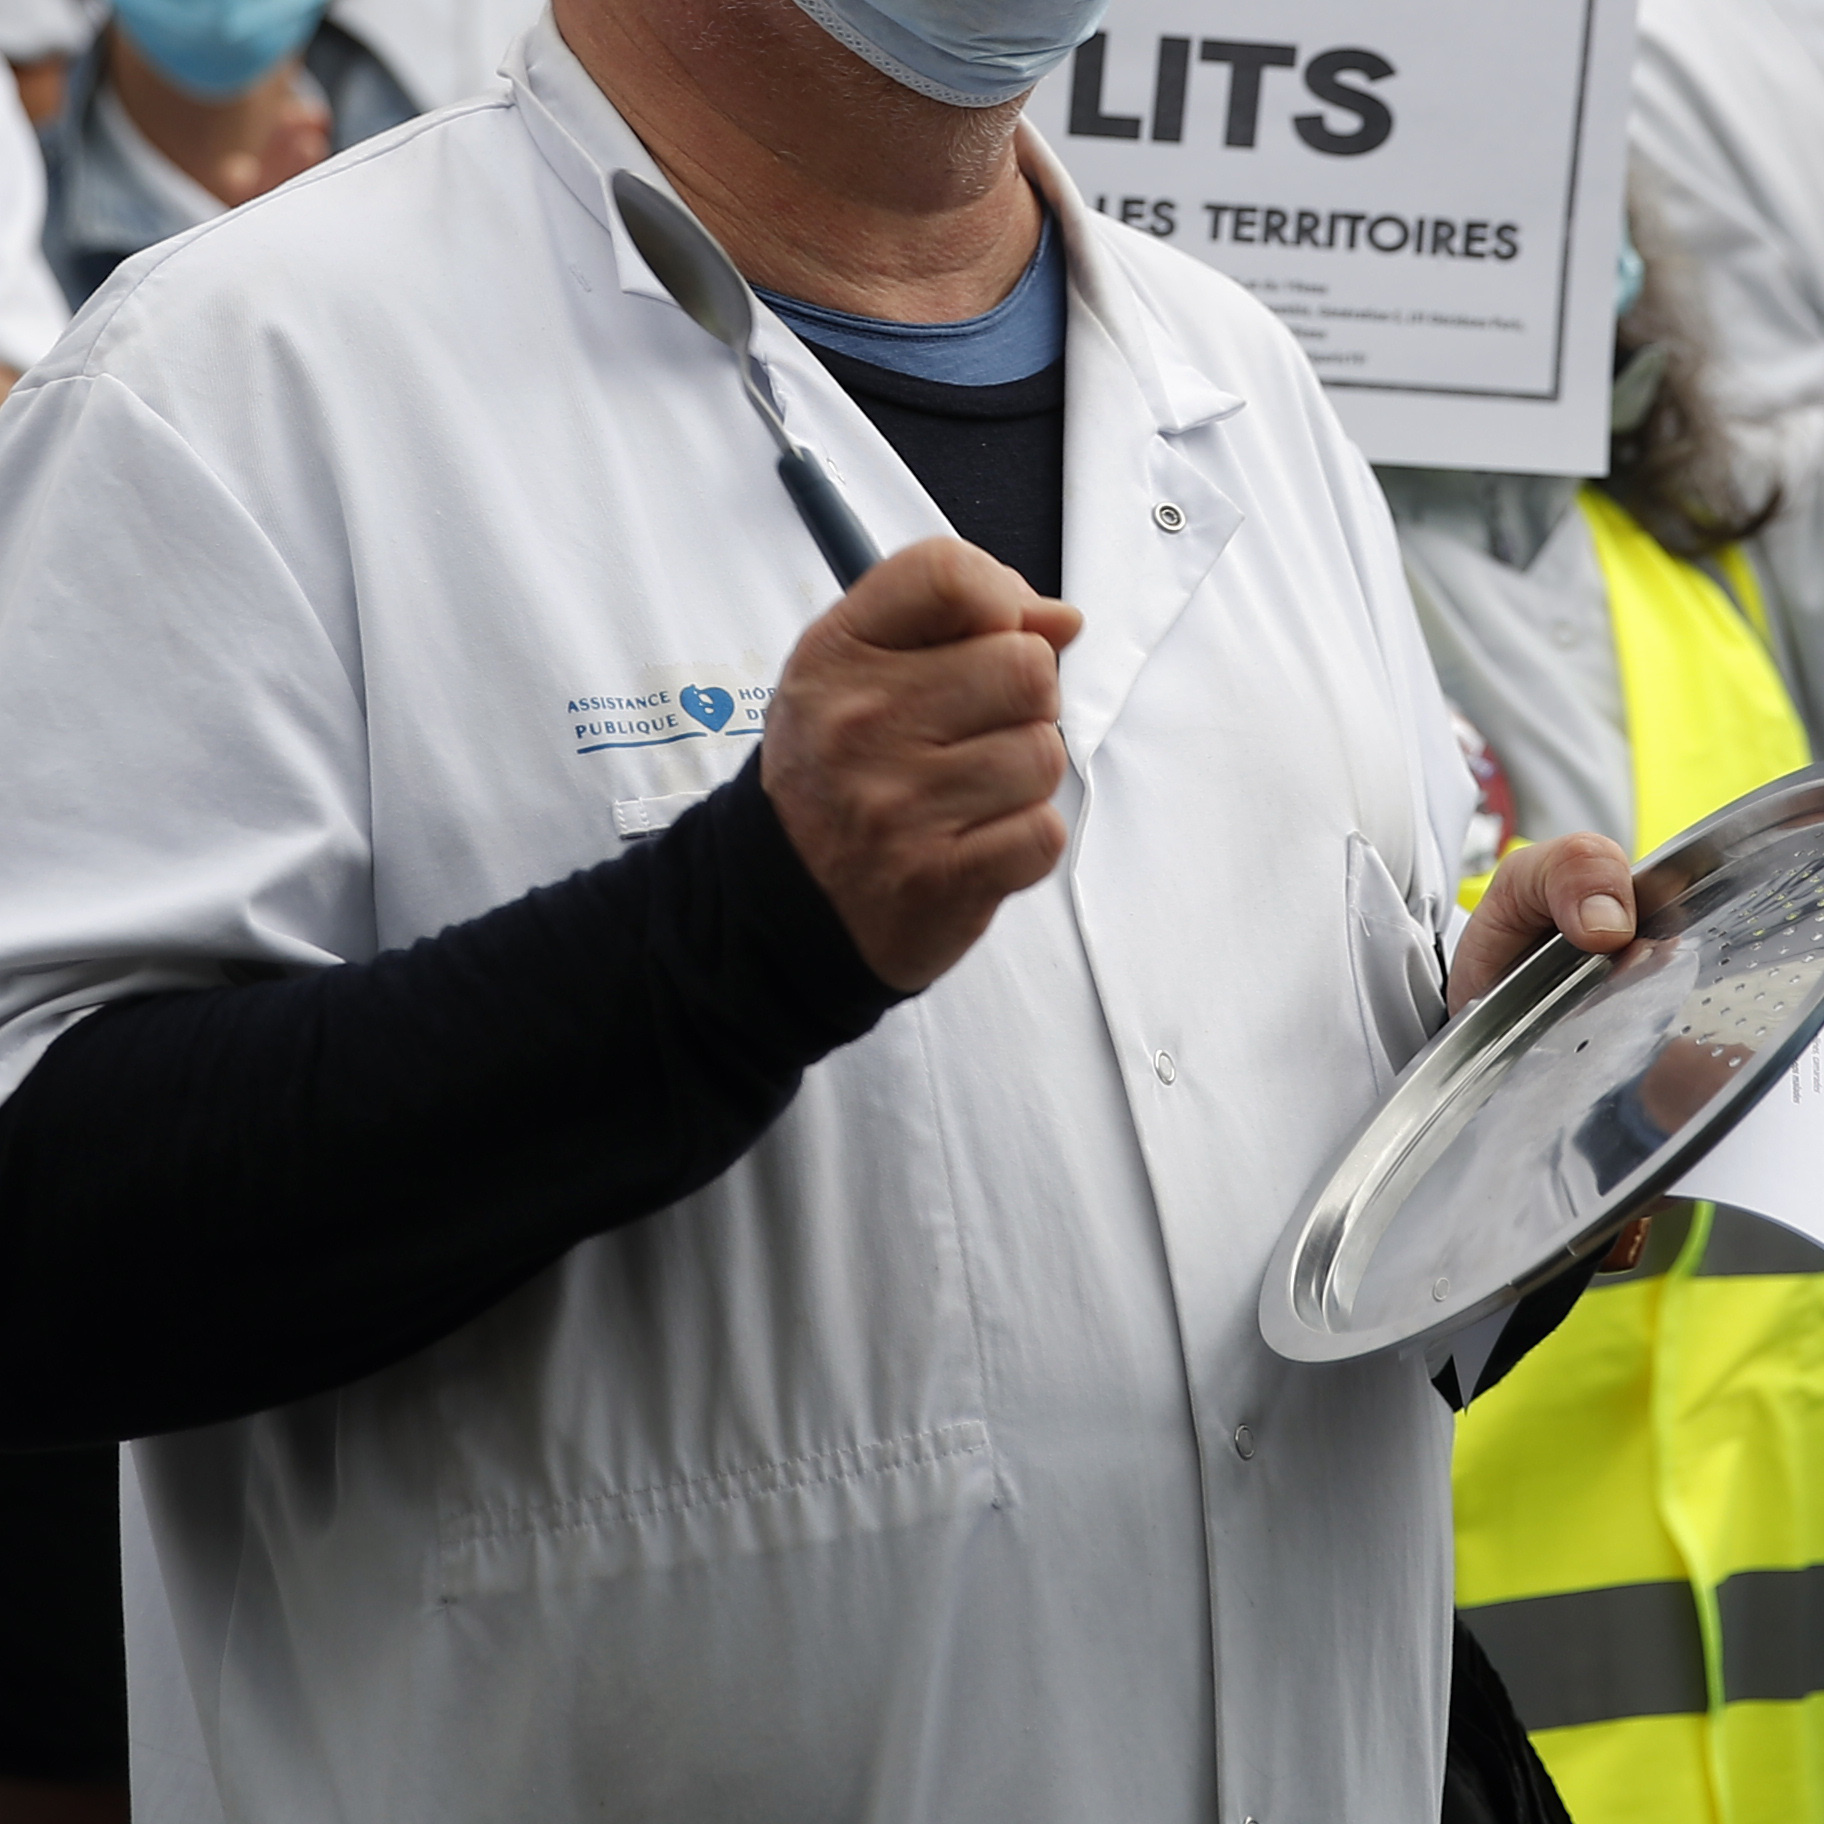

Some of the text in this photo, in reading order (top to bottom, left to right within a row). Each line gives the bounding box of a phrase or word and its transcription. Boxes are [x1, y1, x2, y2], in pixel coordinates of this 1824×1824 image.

[1068, 31, 1396, 157] LITS
[1204, 203, 1521, 261] TERRITOIRES
[567, 691, 671, 713] ASSISTANCE
[575, 714, 679, 739] PUBLIQUE
